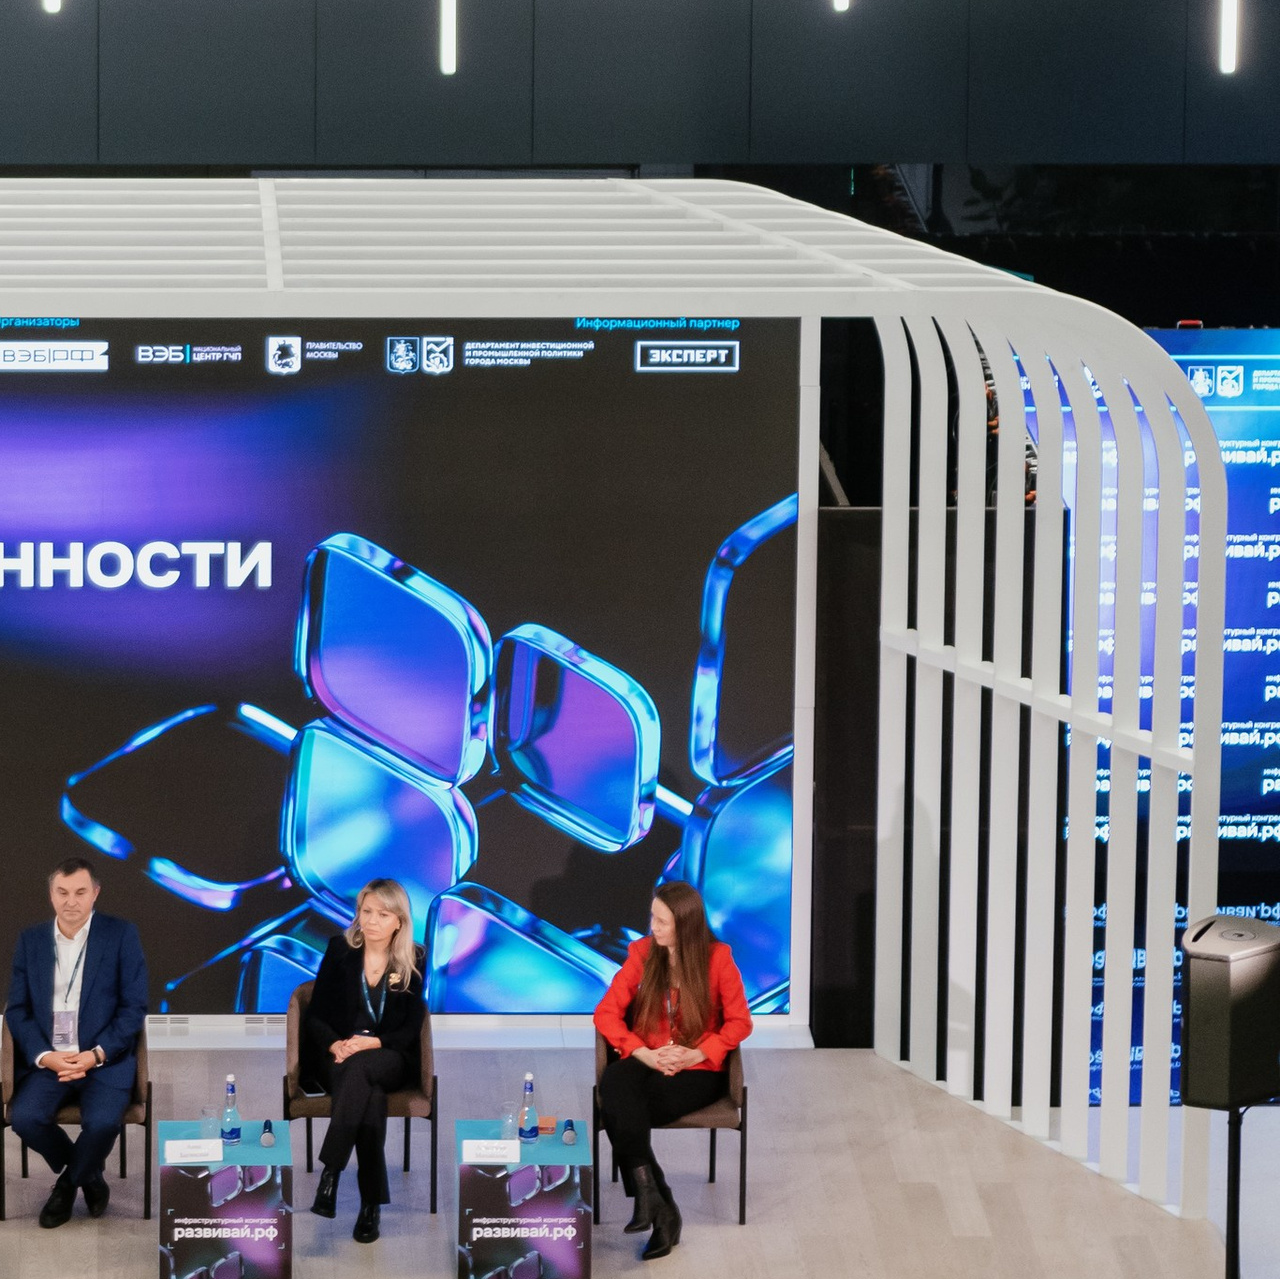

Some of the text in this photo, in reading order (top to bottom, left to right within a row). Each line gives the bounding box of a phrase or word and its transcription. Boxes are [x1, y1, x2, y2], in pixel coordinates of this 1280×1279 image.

[577, 317, 740, 331] Информационный партнер
[137, 345, 184, 362] ВЭБ
[649, 349, 729, 363] ЭКСПЕРТ
[174, 1225, 278, 1241] развивай.рф
[472, 1225, 577, 1241] развивай.рф
